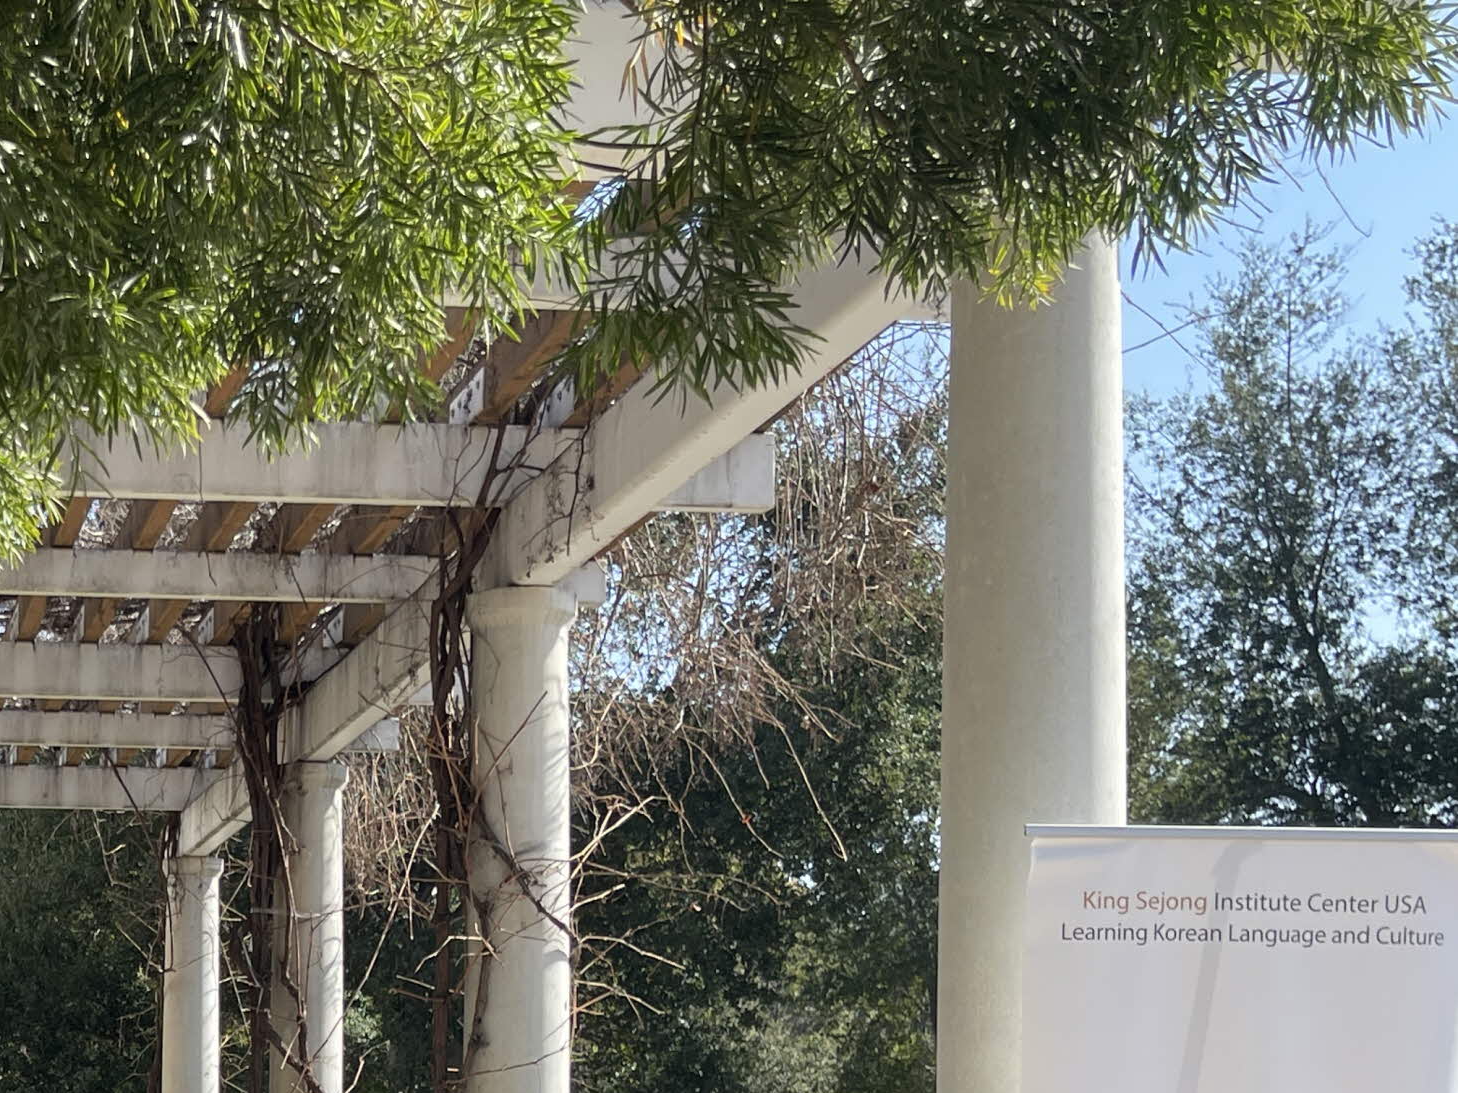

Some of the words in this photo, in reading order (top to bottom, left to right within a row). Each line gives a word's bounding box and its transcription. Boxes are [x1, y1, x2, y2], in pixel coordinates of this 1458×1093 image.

[1082, 891, 1129, 914] King
[1136, 891, 1208, 915] Sejong
[1214, 892, 1302, 913] Institute
[1308, 893, 1379, 913] Center
[1385, 895, 1427, 914] USA
[1061, 923, 1148, 945] Learning
[1153, 924, 1222, 942] Korean
[1228, 925, 1327, 948] Language
[1331, 926, 1370, 944] and
[1376, 927, 1445, 946] Culture
